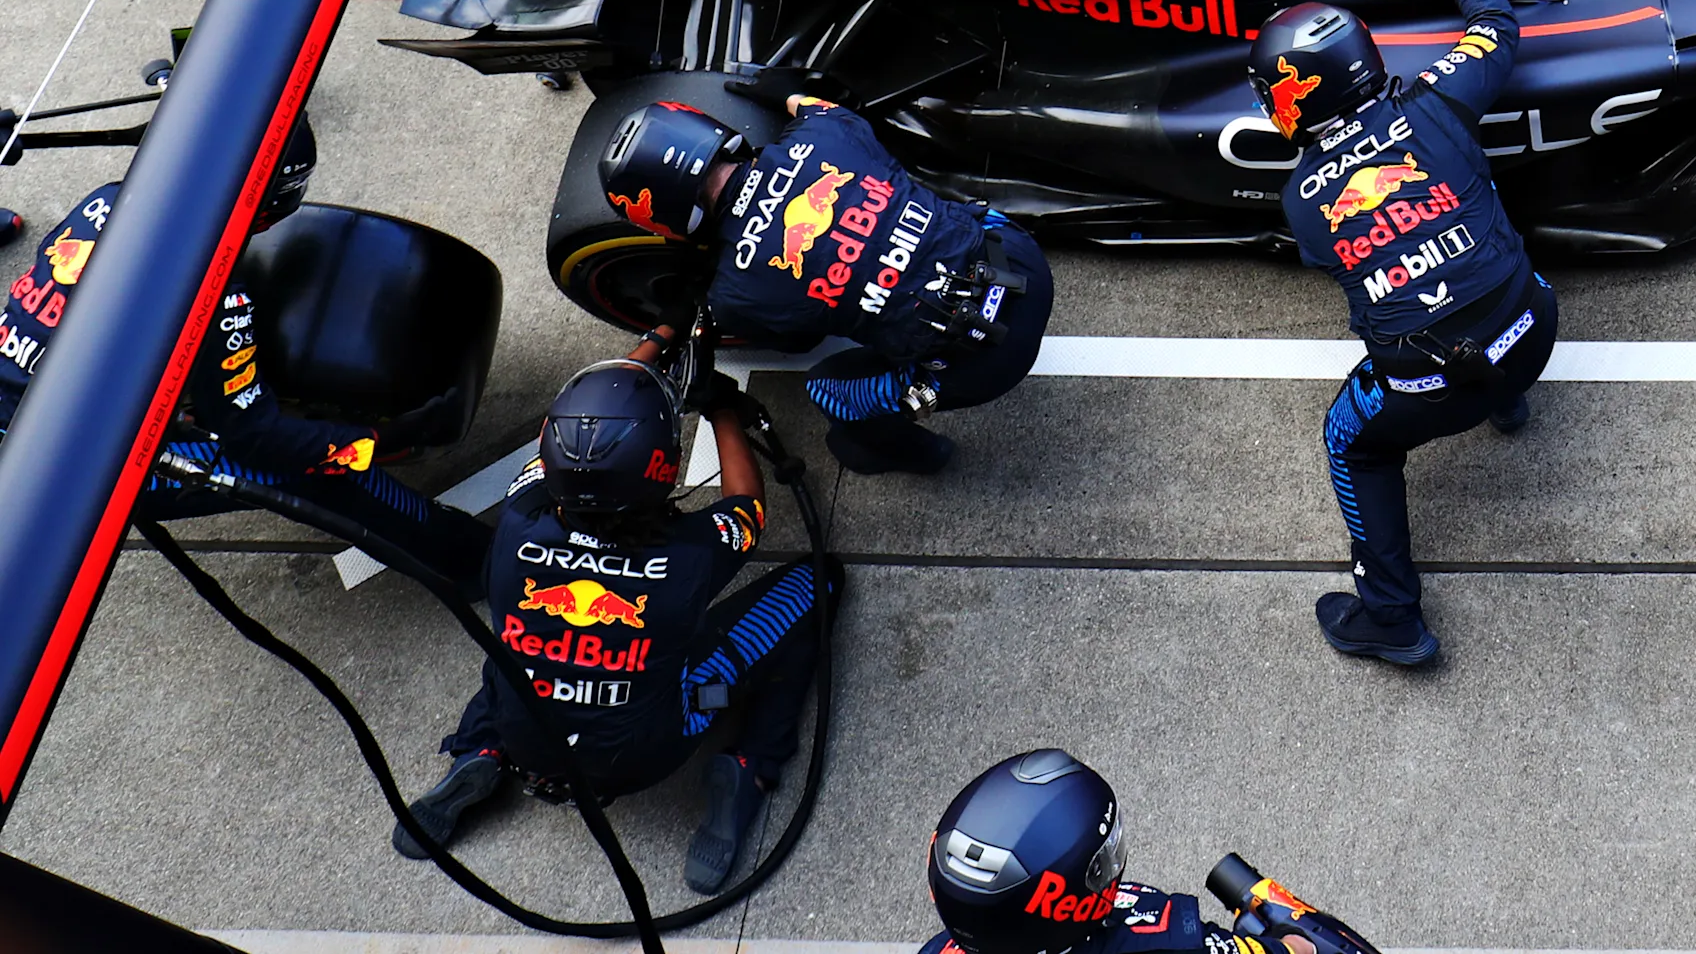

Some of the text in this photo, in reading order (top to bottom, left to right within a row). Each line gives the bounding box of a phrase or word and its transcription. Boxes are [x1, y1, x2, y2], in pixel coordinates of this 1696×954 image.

[1299, 116, 1413, 200] ORACLE
[1319, 121, 1364, 152] sparco
[731, 168, 763, 218] sparco
[735, 142, 814, 270] ORACLE
[807, 174, 894, 308] Red Bull
[1333, 181, 1461, 271] Red Bull
[858, 228, 921, 315] Mobil
[1362, 239, 1445, 304] Mobil
[134, 246, 234, 469] REDBULLRACING.COM
[1484, 311, 1535, 365] sparco
[231, 383, 262, 410] VISA
[1387, 375, 1446, 394] sparco
[643, 449, 679, 485] Red
[516, 542, 669, 580] ORACLE
[501, 613, 651, 672] Red Bull
[1024, 870, 1100, 923] Red
